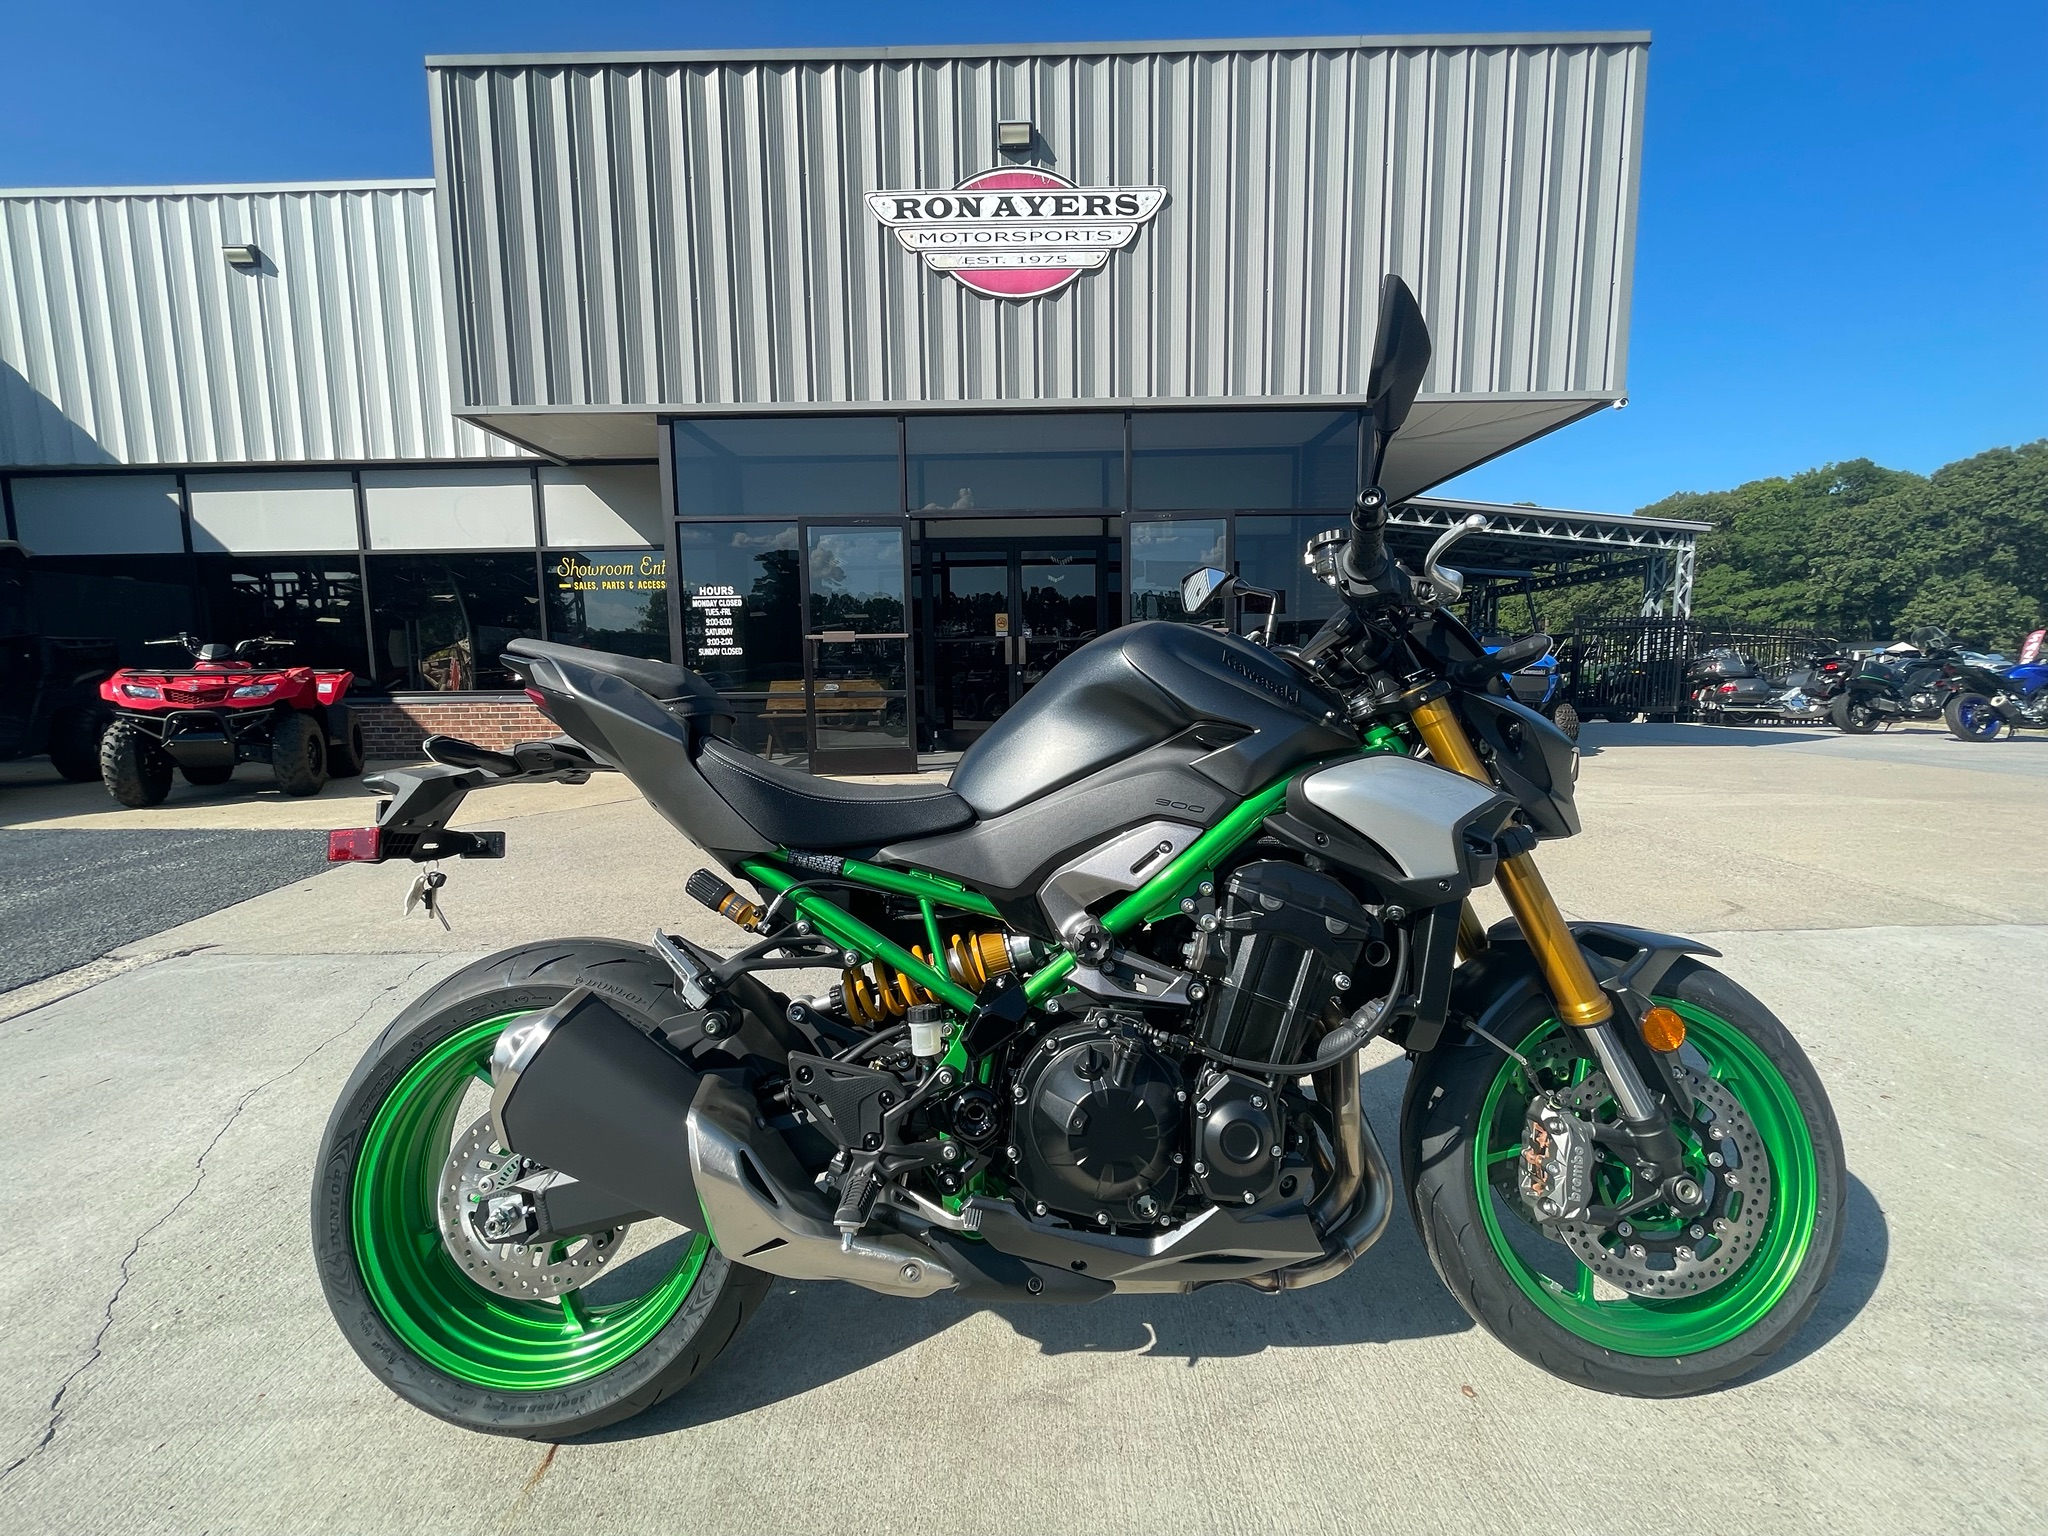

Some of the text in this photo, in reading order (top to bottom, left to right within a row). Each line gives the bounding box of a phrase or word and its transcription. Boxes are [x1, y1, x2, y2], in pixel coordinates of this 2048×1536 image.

[892, 194, 1139, 219] RON AYERS
[919, 230, 1113, 244] MOTORSPORTS
[964, 255, 1067, 264] EST. 1975
[557, 556, 634, 578] Showroom
[573, 580, 668, 590] SALES, PARTS & ACCESS
[699, 586, 734, 595] HOURS
[692, 599, 742, 607] MONDAY CLOSED
[704, 628, 734, 636] SATURDAY
[698, 647, 743, 656] SUNDAY CLOSED
[1154, 797, 1205, 814] 900
[585, 979, 647, 1005] DUNLOP
[1568, 1146, 1584, 1202] brembo
[329, 1168, 342, 1247] DUNLOP
